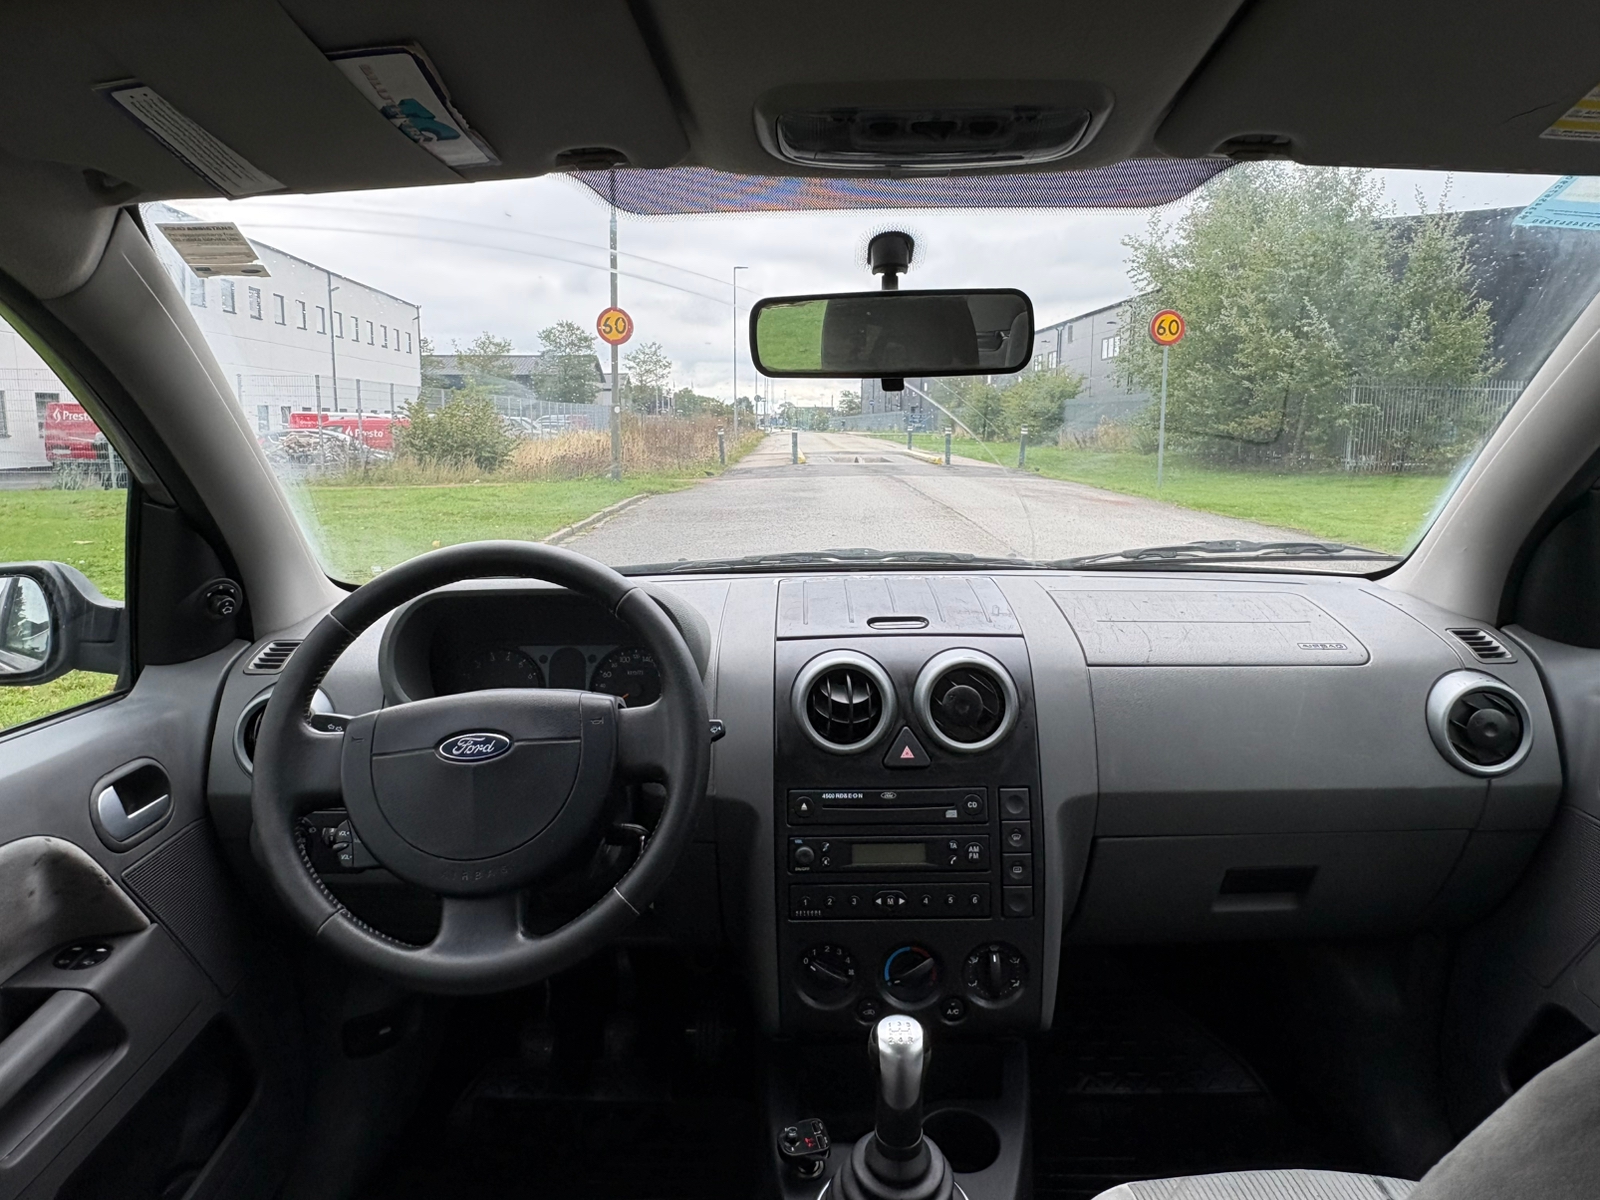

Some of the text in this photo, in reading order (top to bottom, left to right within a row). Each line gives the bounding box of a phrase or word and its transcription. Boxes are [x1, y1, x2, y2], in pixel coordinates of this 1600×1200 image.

[602, 316, 627, 335] 60
[1156, 318, 1180, 336] 60
[619, 656, 631, 664] 100
[452, 737, 496, 755] Ford
[968, 852, 980, 860] FM
[803, 898, 807, 906] 1
[827, 897, 833, 906] 2
[851, 897, 857, 905] 3
[886, 897, 894, 905] M
[812, 948, 816, 956] 1
[824, 945, 831, 953] 2
[836, 947, 842, 956] 3
[803, 957, 809, 965] 0
[844, 956, 851, 964] 4
